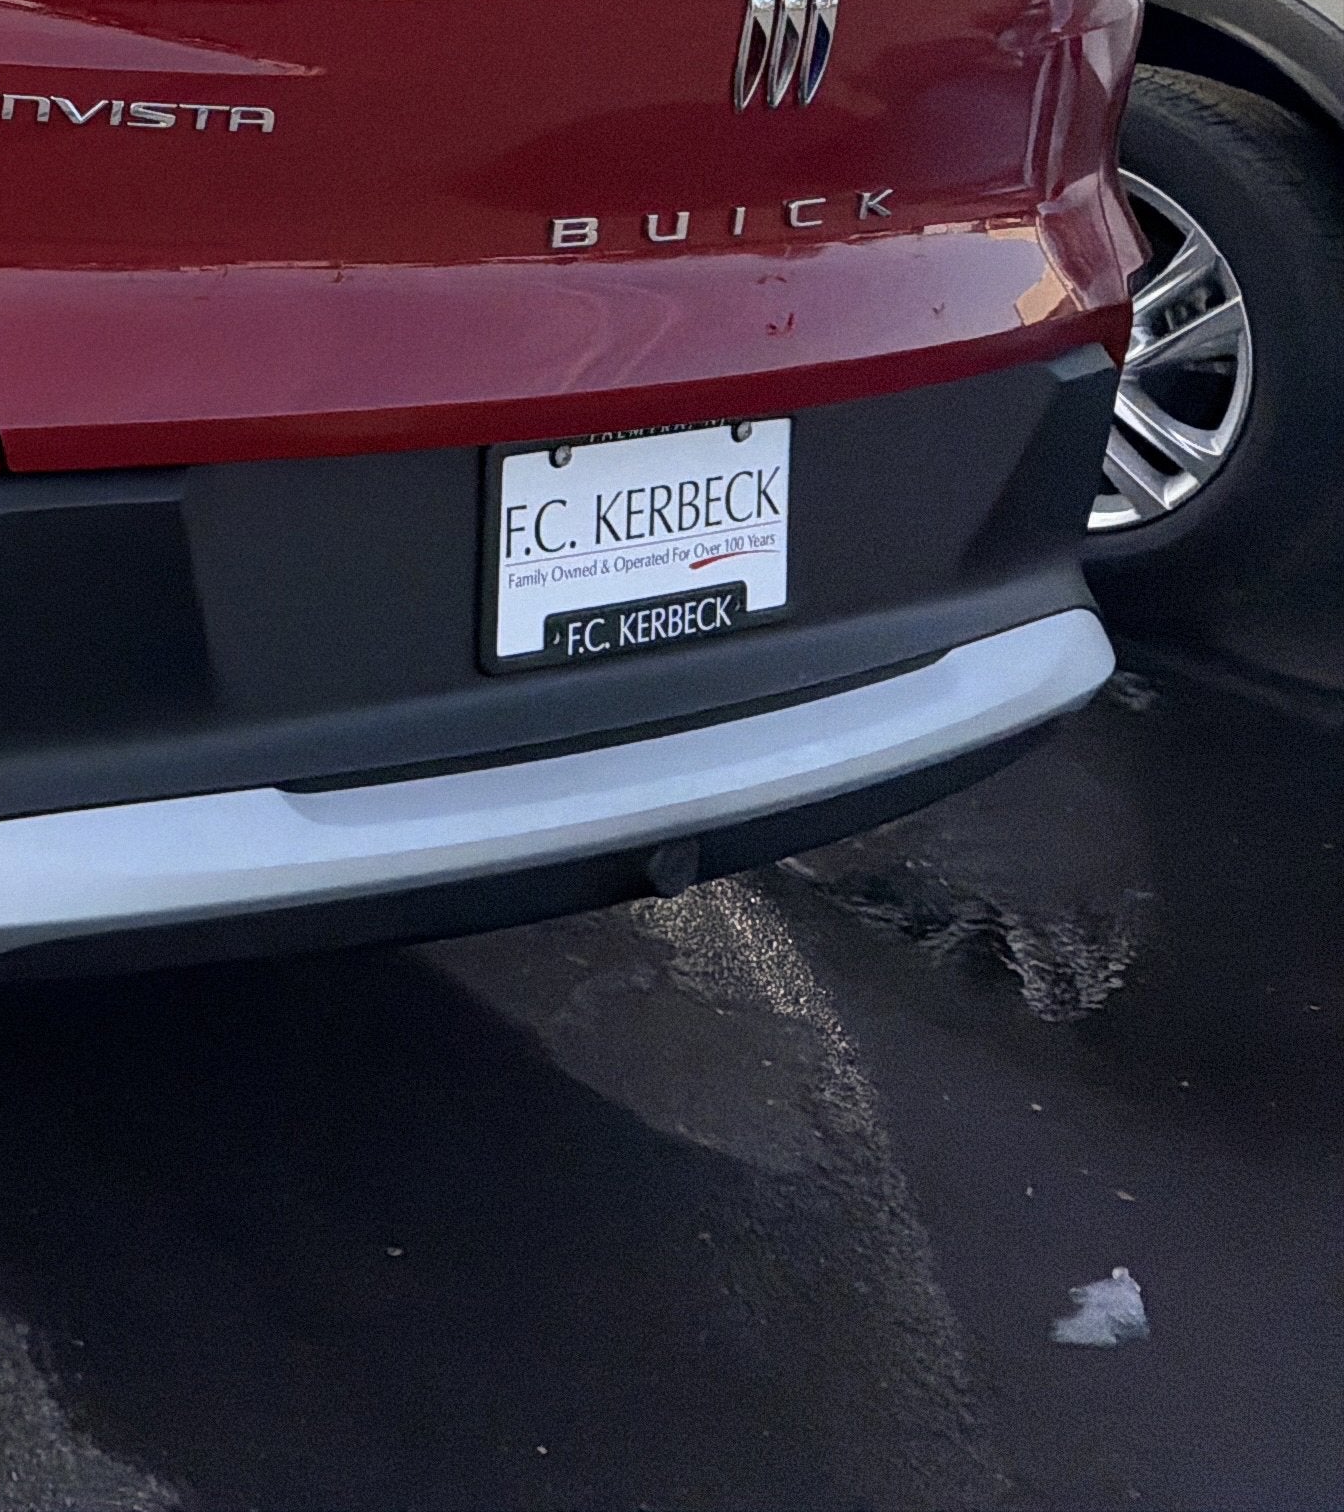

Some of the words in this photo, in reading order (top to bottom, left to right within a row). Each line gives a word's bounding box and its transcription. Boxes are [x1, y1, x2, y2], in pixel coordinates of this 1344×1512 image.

[550, 187, 894, 251] BUICK
[505, 499, 577, 558] F.C.
[595, 465, 781, 545] KERBECK
[508, 568, 548, 589] Family
[552, 559, 598, 582] Owned
[600, 559, 610, 574] &
[614, 547, 670, 573] Operated
[672, 547, 691, 563] For
[693, 542, 722, 558] Over
[724, 536, 745, 552] 100
[747, 533, 776, 548] Years
[567, 618, 610, 656] F.C.
[619, 594, 733, 647] KERBECK
